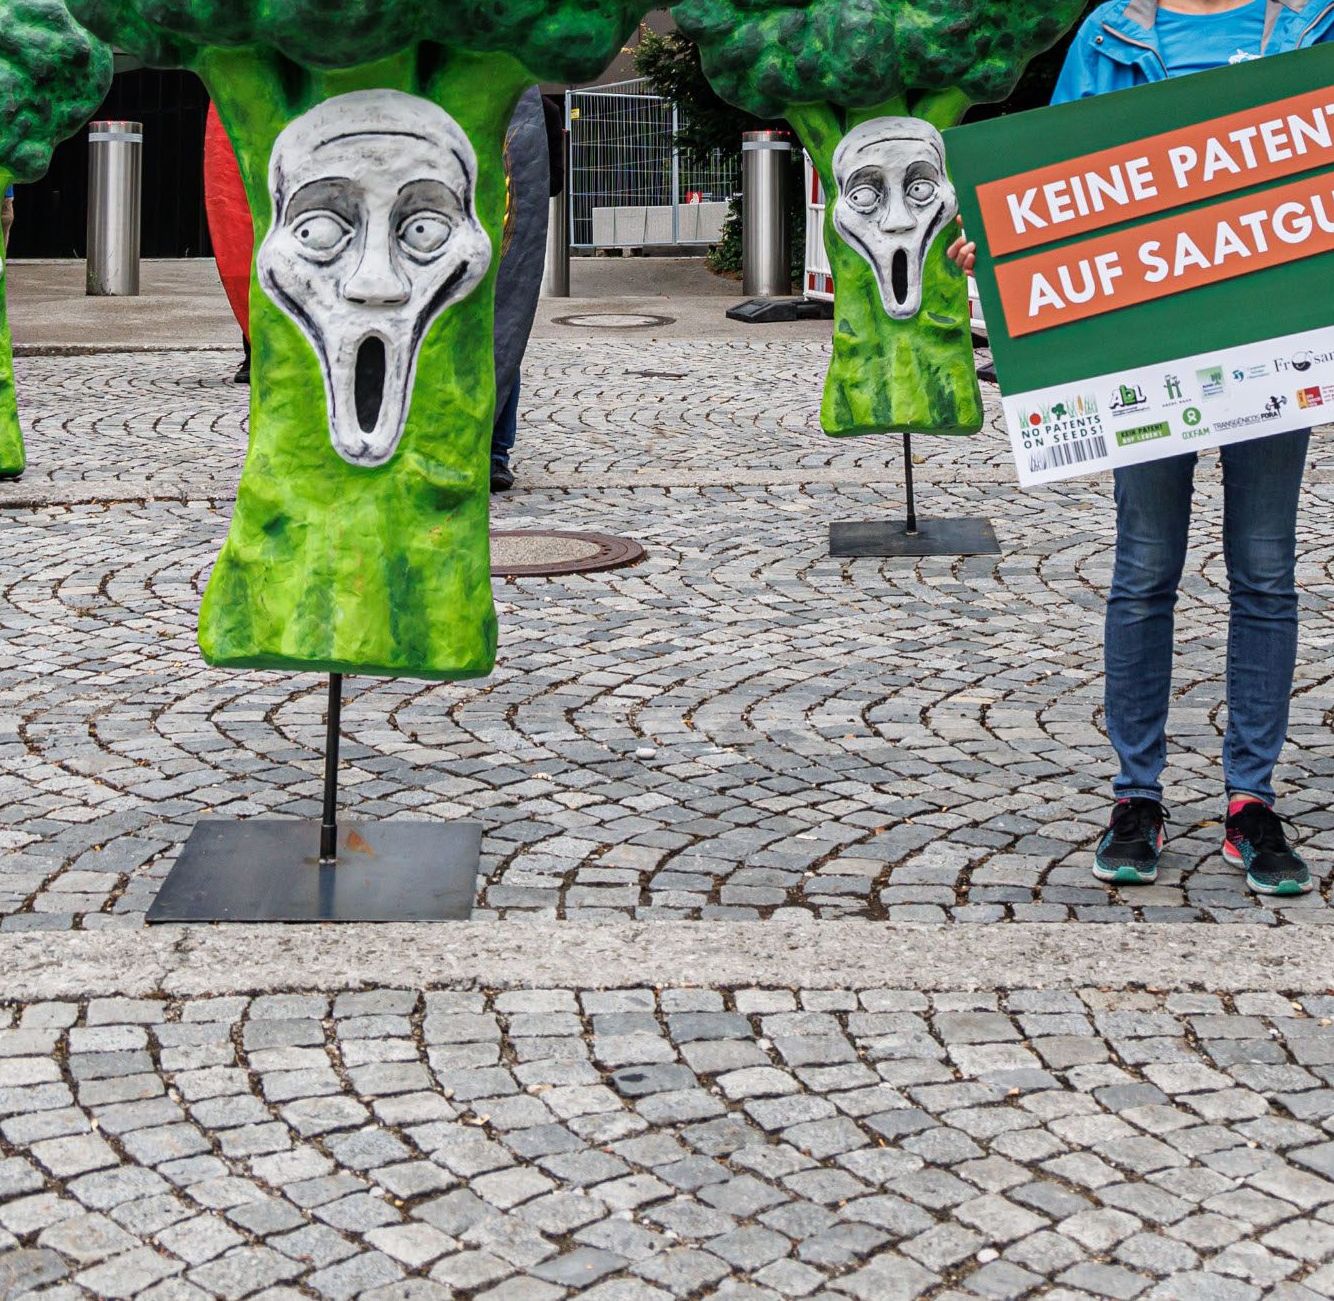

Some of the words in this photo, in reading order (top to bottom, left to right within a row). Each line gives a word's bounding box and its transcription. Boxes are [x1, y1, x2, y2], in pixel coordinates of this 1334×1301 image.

[1006, 156, 1158, 234] KEINE
[1028, 251, 1124, 317] AUF
[1021, 428, 1040, 439] NO
[1045, 414, 1101, 434] PATENTS
[1024, 437, 1044, 449] ON
[1054, 425, 1104, 443] SEEDS!
[1182, 426, 1210, 439] OXFAM
